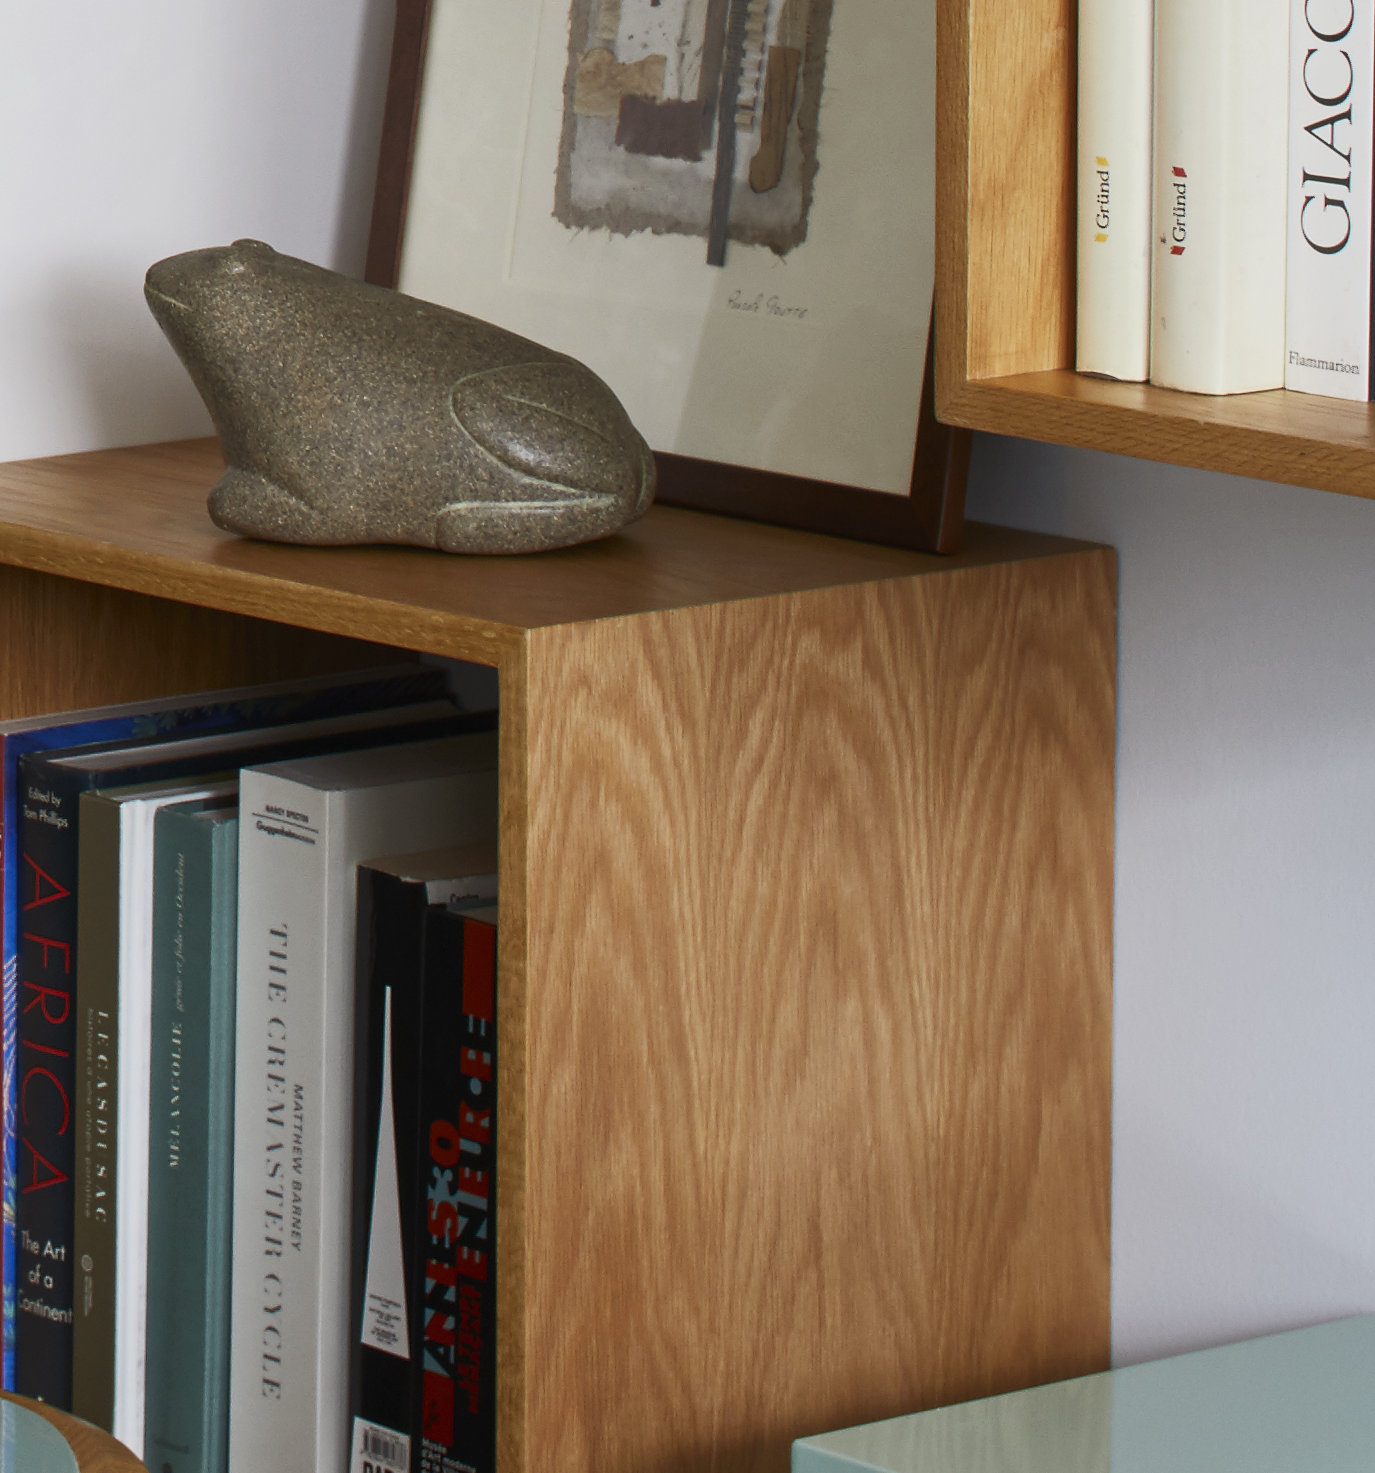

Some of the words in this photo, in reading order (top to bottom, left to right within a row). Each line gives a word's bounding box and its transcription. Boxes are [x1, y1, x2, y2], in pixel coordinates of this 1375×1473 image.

[1095, 170, 1110, 229] Gründ
[1172, 182, 1187, 243] Gründ
[1288, 350, 1360, 375] Flammarion
[51, 791, 62, 808] by
[267, 923, 289, 1004] THE
[21, 852, 71, 1195] AFRICA
[263, 1015, 288, 1260] CREMASTER
[292, 1083, 305, 1175] MATTHEW
[20, 1229, 40, 1255] The
[42, 1239, 66, 1263] Art
[290, 1178, 303, 1253] BARNEY
[17, 1288, 73, 1325] Continent
[28, 1263, 42, 1285] of
[43, 1274, 54, 1289] a
[261, 1271, 283, 1402] CYCLE
